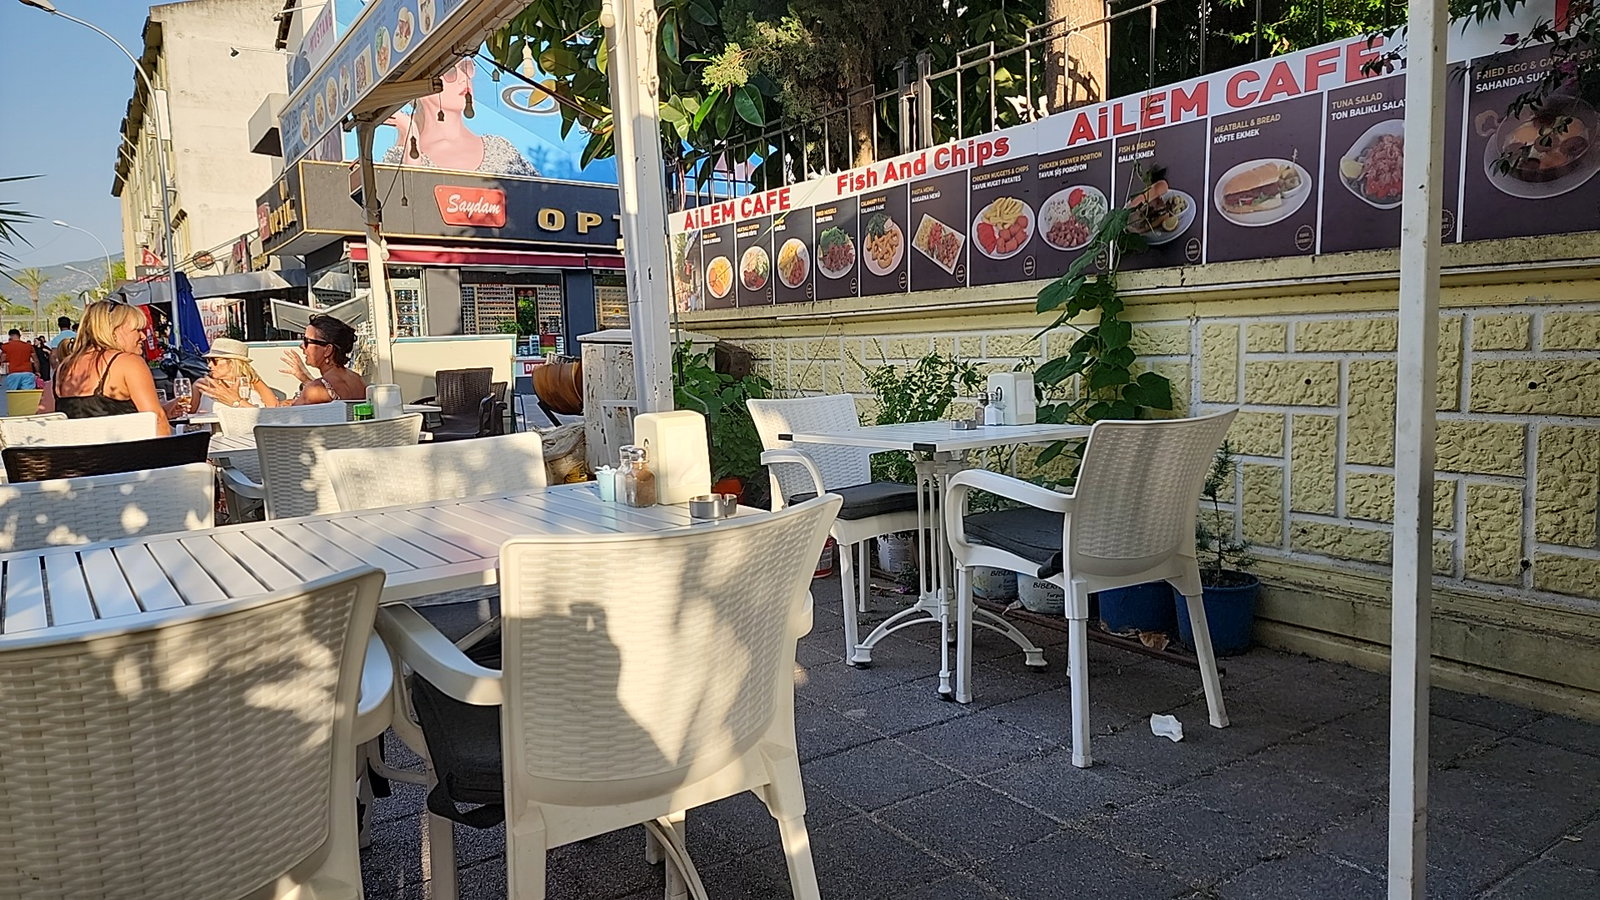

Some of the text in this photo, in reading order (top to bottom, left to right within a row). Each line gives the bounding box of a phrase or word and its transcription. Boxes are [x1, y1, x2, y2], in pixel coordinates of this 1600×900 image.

[1225, 36, 1385, 108] CAFE
[1476, 66, 1505, 80] FRIED
[1507, 60, 1528, 74] EGG
[1530, 60, 1537, 70] &
[1475, 75, 1525, 93] SAHANDA
[1331, 92, 1383, 109] TUNA SALAD
[1331, 110, 1348, 120] TON
[1349, 103, 1381, 117] BALIKLI
[1214, 113, 1281, 134] MEATBALL & BREAD
[1213, 128, 1260, 144] KÖFTE EKMEK
[1118, 145, 1131, 154] FISH
[1136, 140, 1156, 151] BREAD
[837, 136, 1010, 196] Fish And Chips
[1038, 160, 1058, 170] CHICKEN
[1080, 151, 1103, 161] PORTION
[1118, 153, 1135, 163] BALIK
[447, 194, 500, 218] Saydam
[741, 187, 791, 219] CAFE
